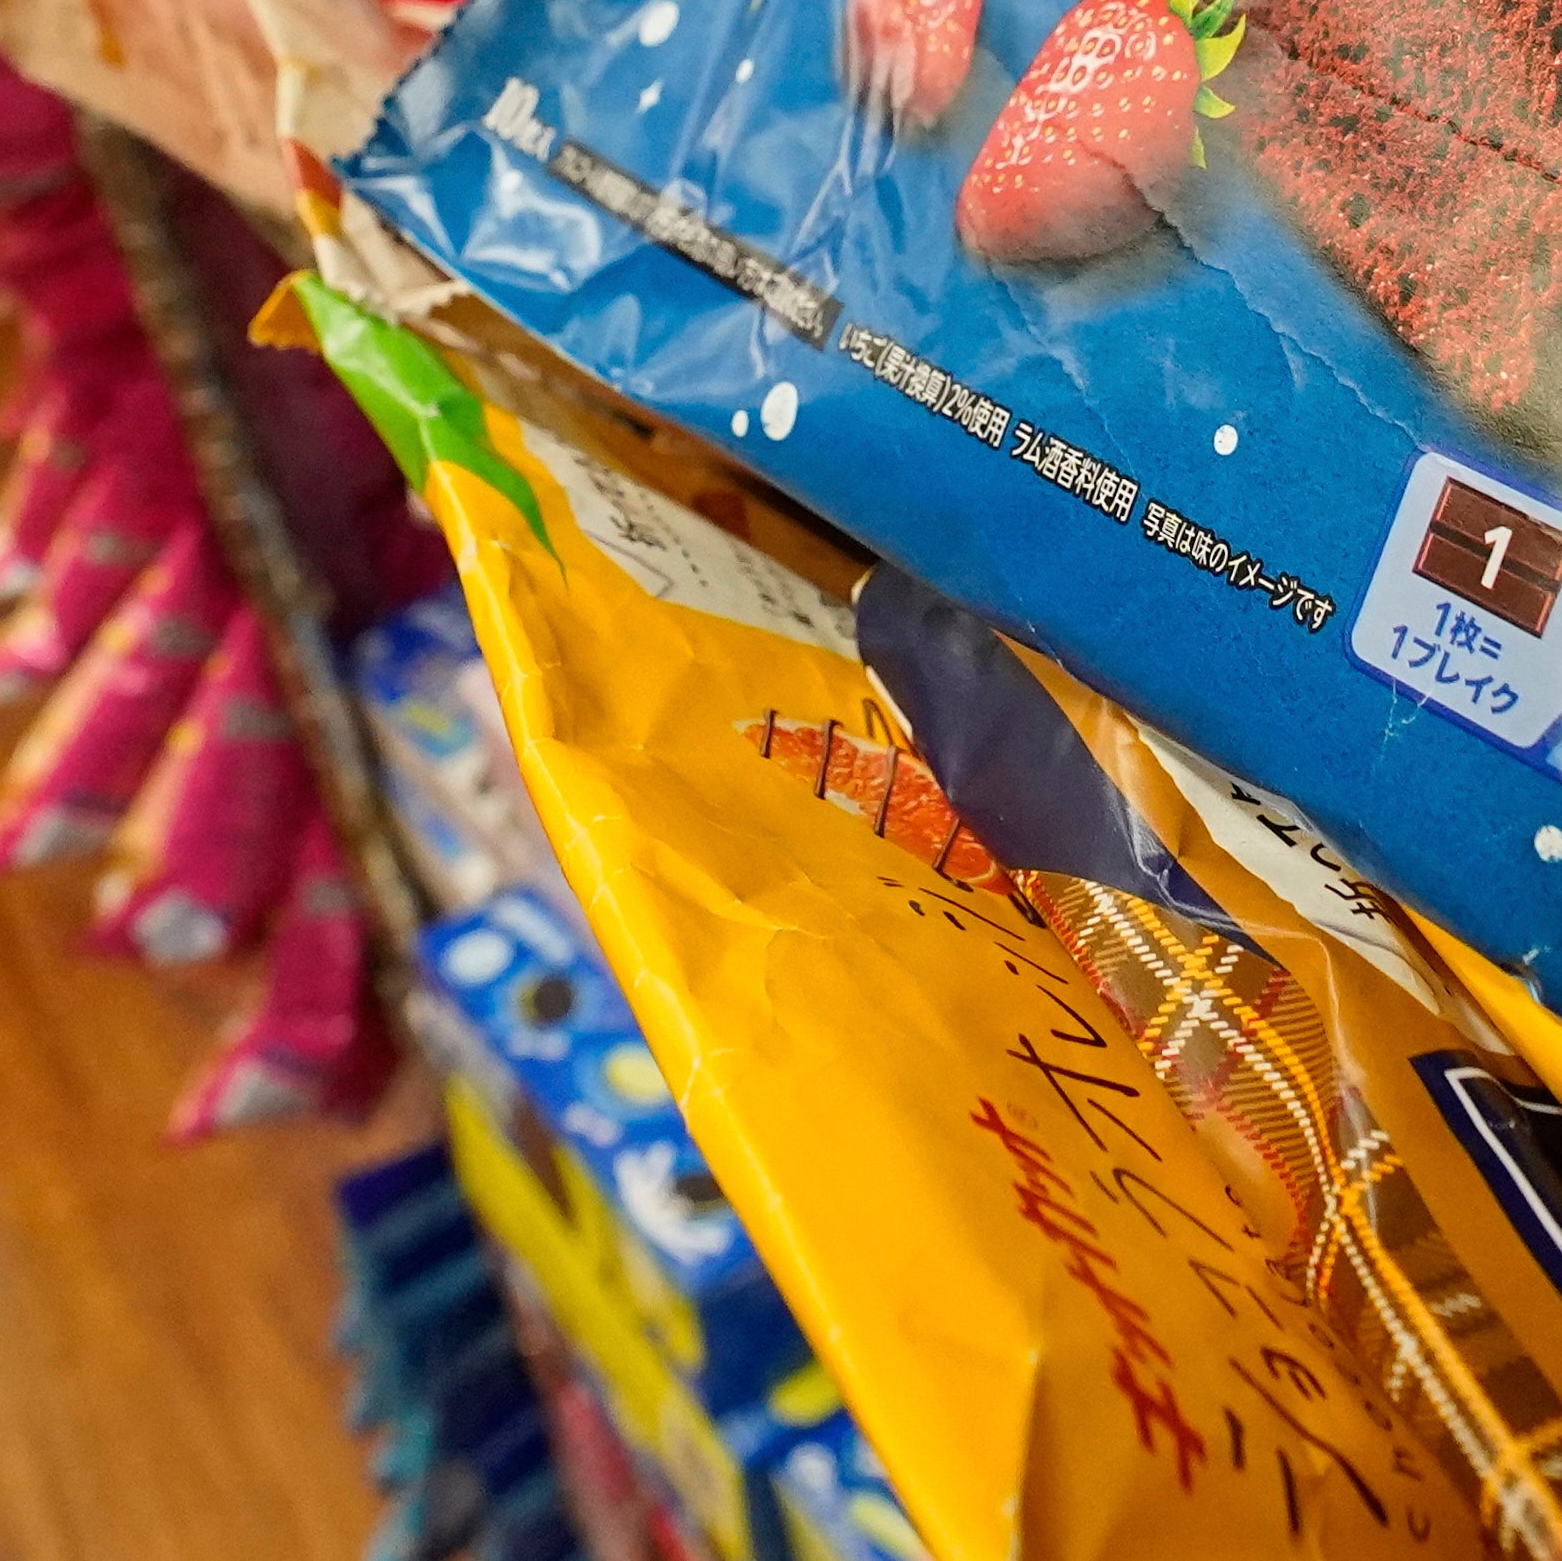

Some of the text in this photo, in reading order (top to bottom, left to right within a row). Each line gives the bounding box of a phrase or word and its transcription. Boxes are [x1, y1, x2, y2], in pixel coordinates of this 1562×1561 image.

[1010, 420, 1139, 523] ラム酒香料使用
[1142, 501, 1336, 630] 写真は味のイメージです
[1482, 524, 1514, 591] 1
[1391, 622, 1520, 716] 1ブレイク
